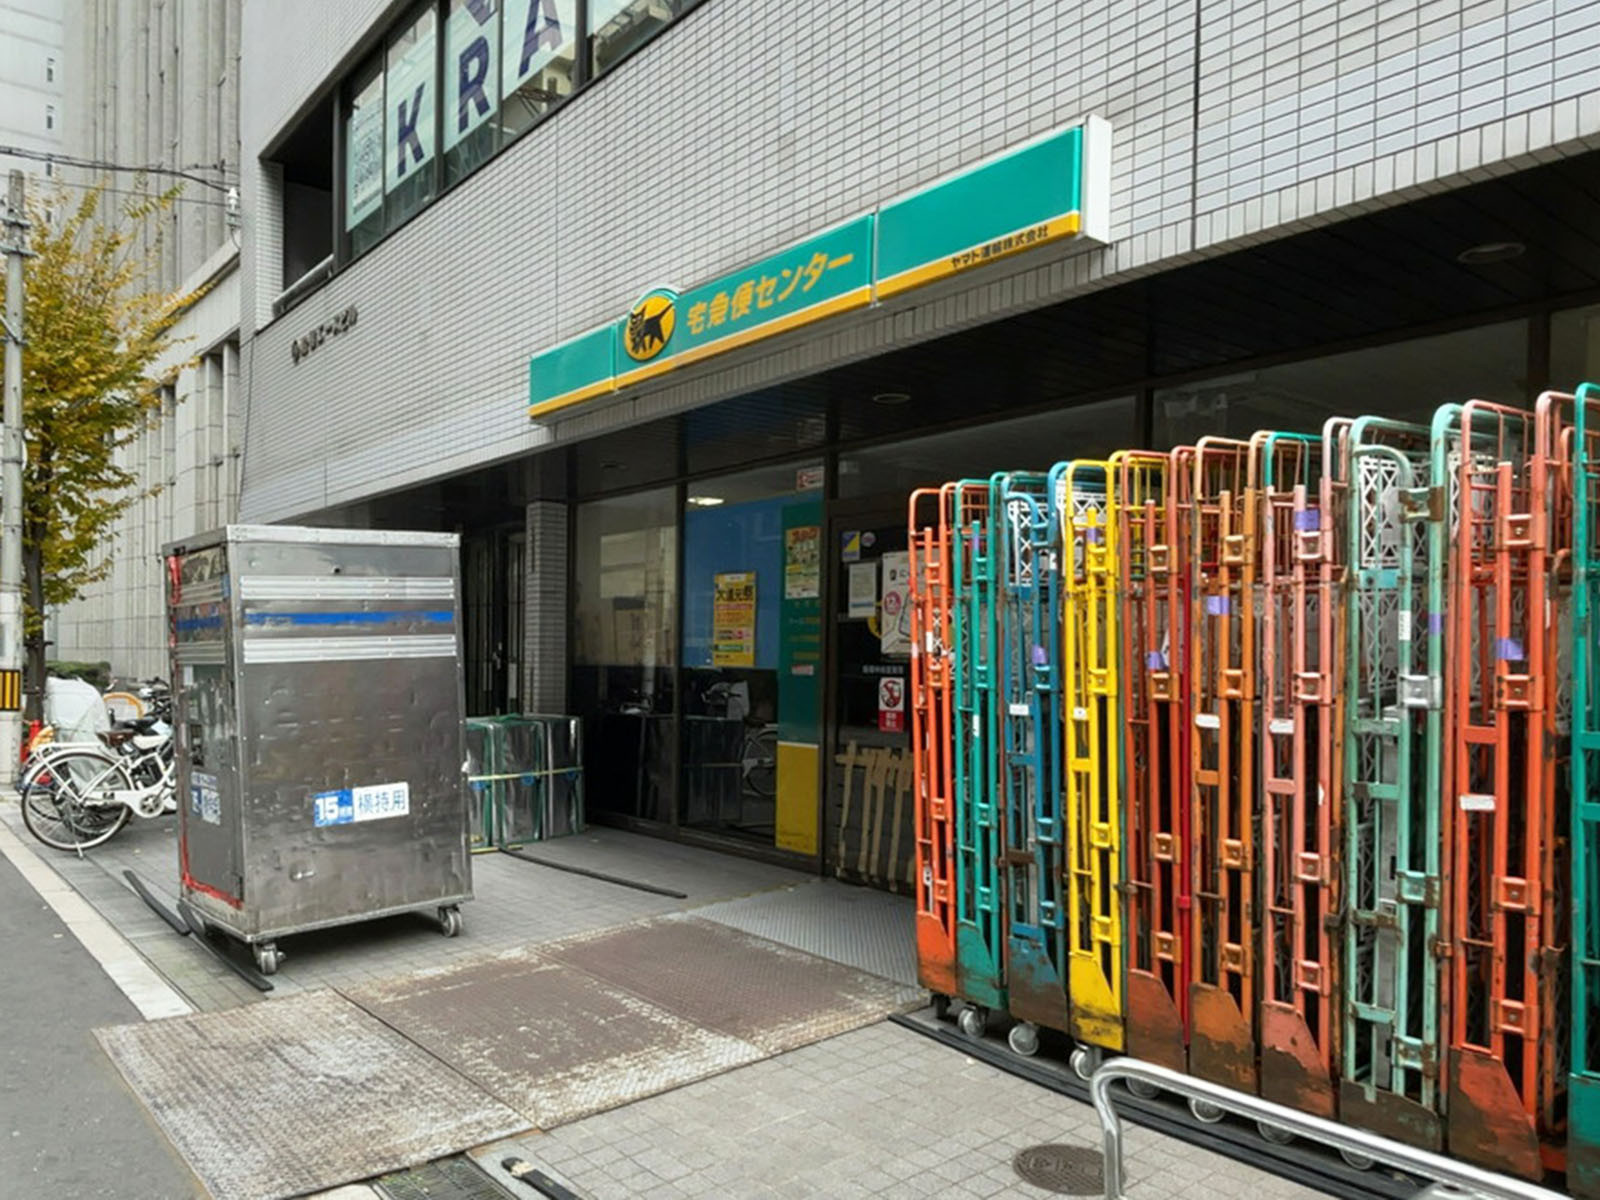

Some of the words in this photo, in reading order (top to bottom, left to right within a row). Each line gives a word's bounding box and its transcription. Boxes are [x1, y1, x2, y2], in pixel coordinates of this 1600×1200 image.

[686, 252, 854, 335] 宅急便センター
